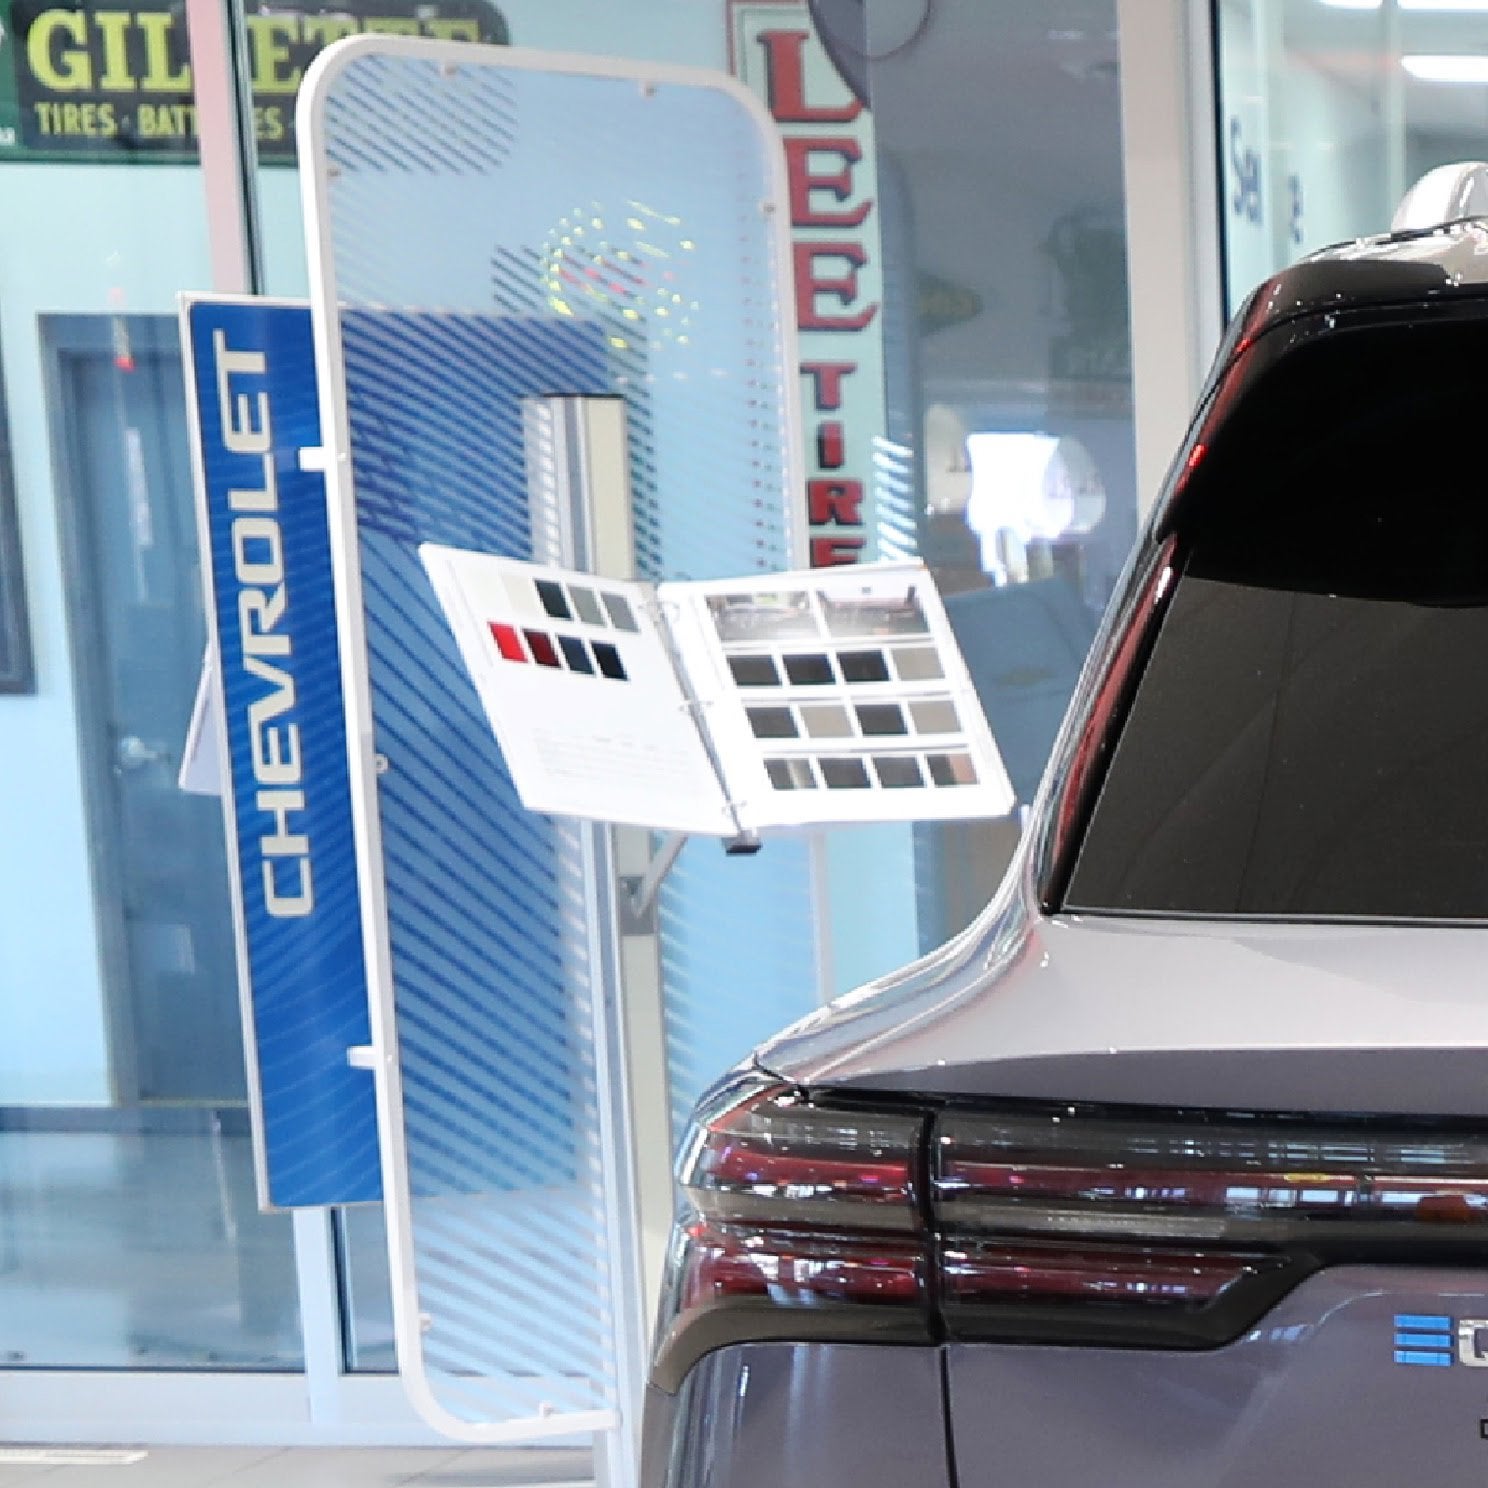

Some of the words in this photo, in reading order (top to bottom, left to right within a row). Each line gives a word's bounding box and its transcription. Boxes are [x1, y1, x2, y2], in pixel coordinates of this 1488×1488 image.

[35, 102, 118, 137] TIRES
[757, 29, 879, 331] LEE
[799, 360, 867, 568] TIRE
[212, 328, 315, 918] CHEVROLET
